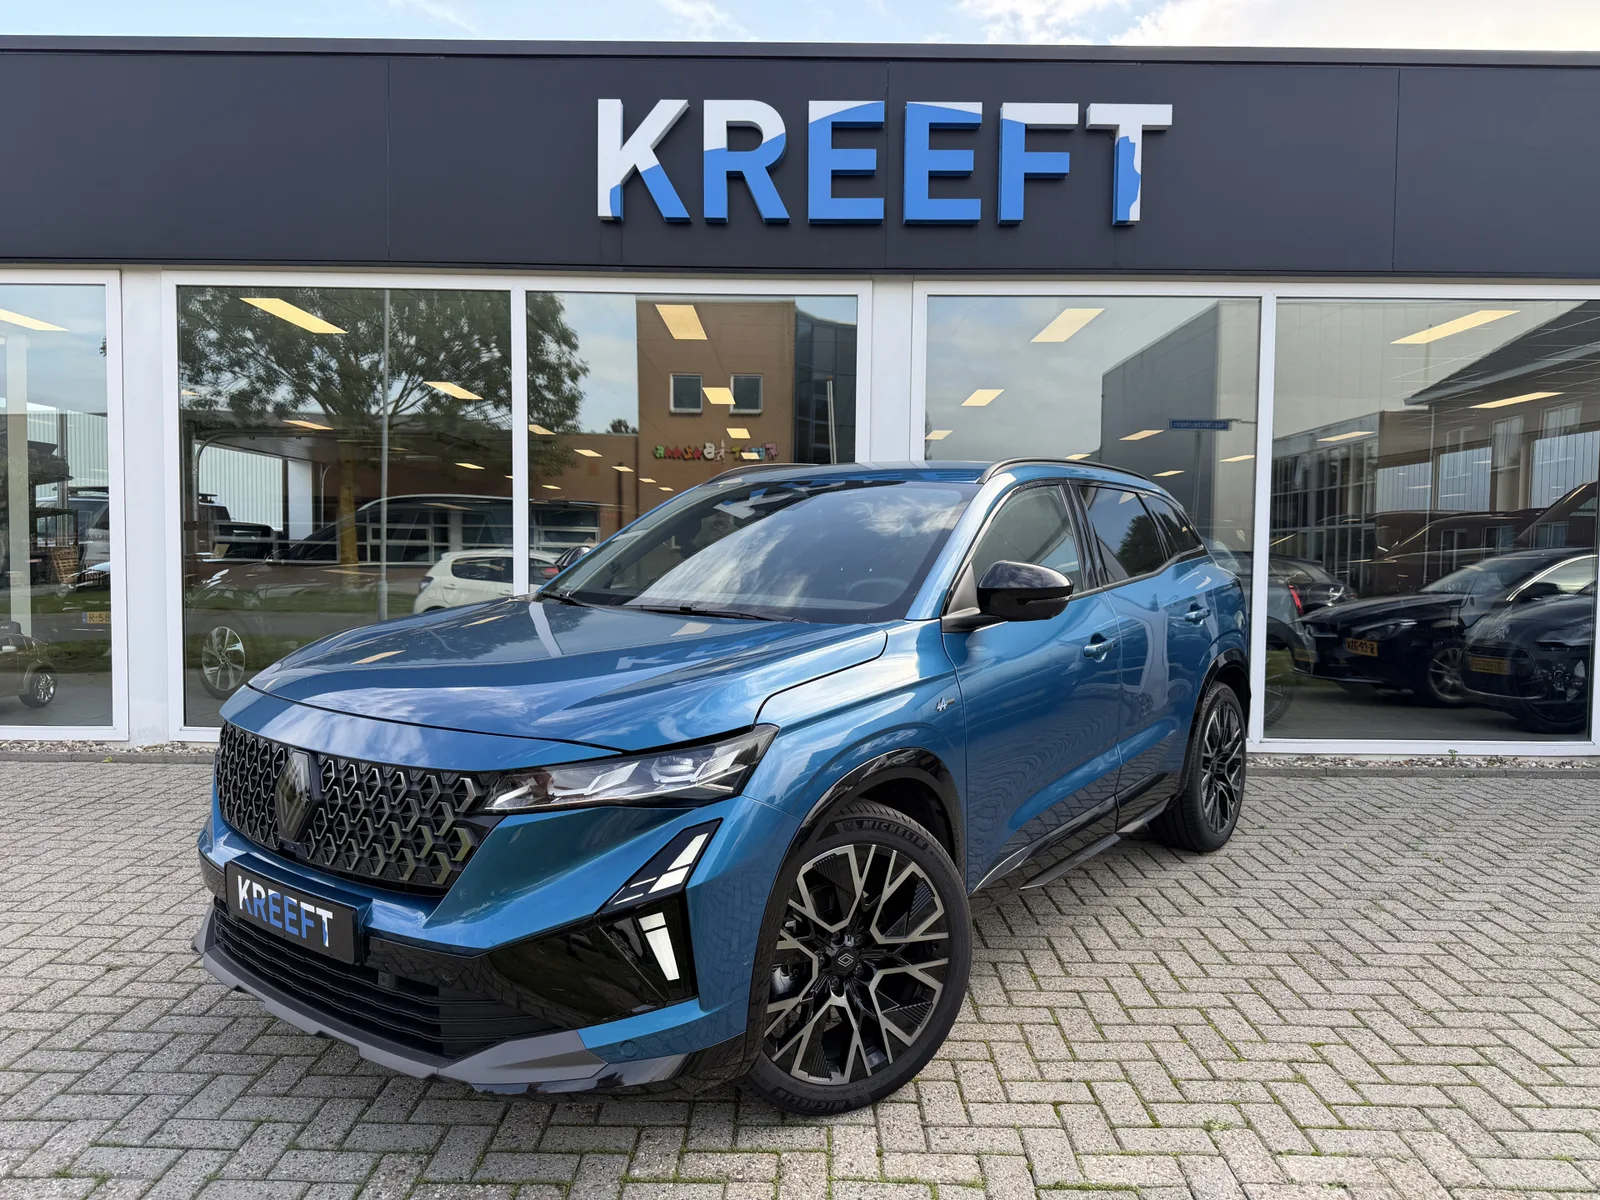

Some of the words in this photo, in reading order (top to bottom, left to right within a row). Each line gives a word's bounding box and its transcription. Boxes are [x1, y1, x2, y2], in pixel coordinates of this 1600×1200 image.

[598, 99, 1173, 225] KREEFT
[88, 613, 110, 623] R-58
[862, 820, 928, 849] MICHELIN
[237, 875, 333, 947] KREEFT
[775, 1087, 848, 1111] MICHELIN
